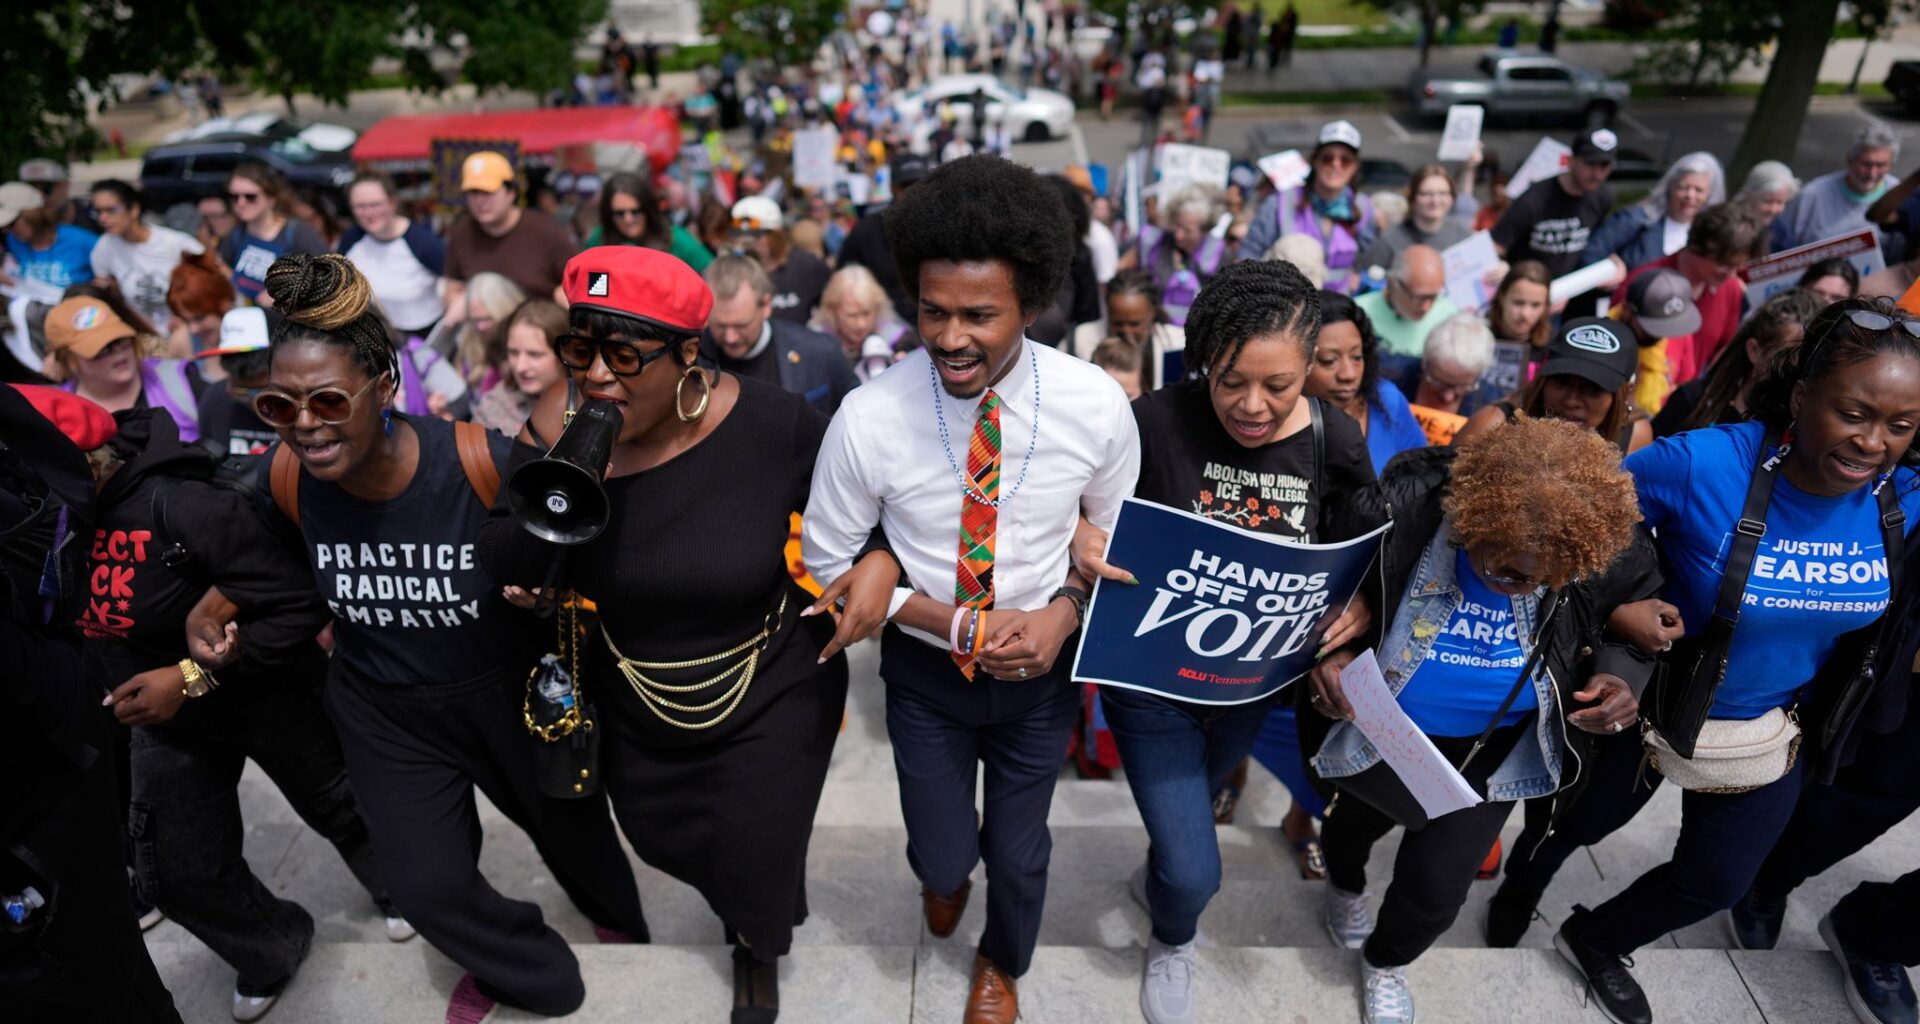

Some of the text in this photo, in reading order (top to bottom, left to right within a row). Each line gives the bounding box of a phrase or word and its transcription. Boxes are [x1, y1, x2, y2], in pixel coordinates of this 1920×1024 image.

[1203, 461, 1259, 488] ABOLISH
[1260, 473, 1275, 487] NO
[1216, 481, 1242, 501] ICE
[1261, 486, 1309, 503] IS ILLEGAL
[90, 529, 152, 562] ECT
[316, 542, 475, 571] PRACTICE
[1772, 538, 1863, 557] JUSTIN J.
[1189, 549, 1330, 593] HANDS
[1753, 554, 1889, 585] EARSON
[336, 573, 461, 602] RADICAL
[1166, 568, 1330, 613] OFF OUR
[1805, 587, 1824, 597] for
[327, 599, 480, 628] EMPATHY
[1133, 587, 1330, 662] VOTE
[1472, 645, 1488, 655] for
[1177, 667, 1264, 685] ACLU Tennessee
